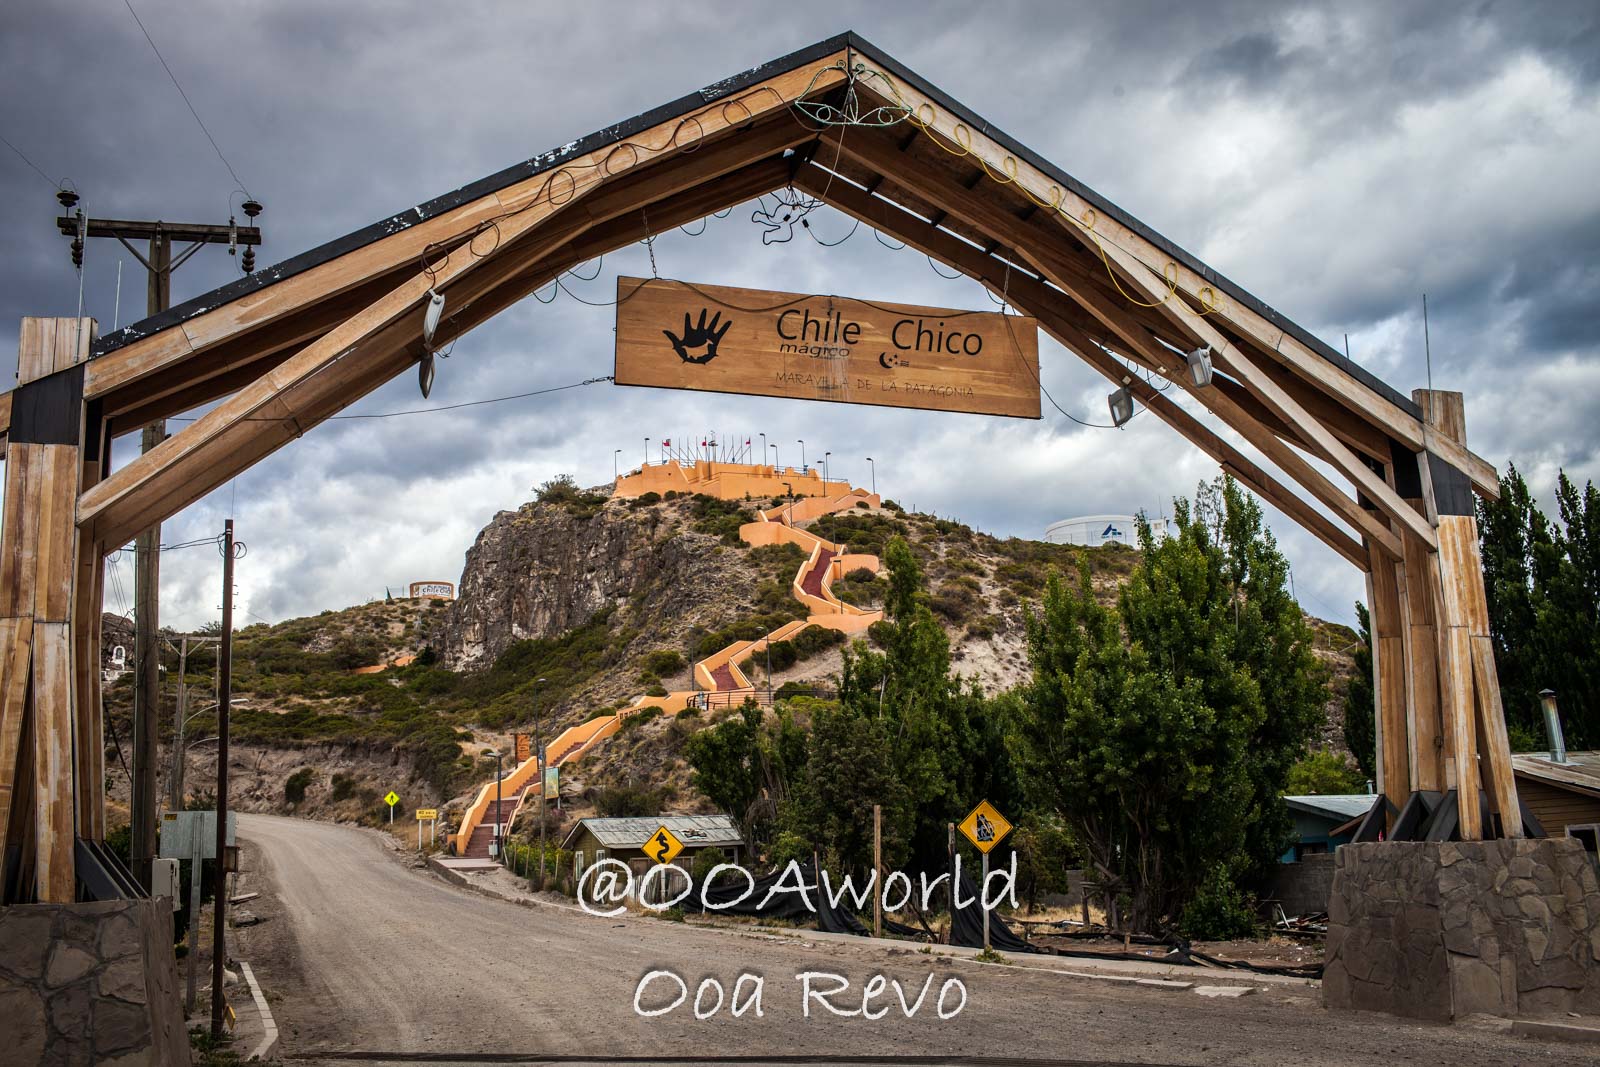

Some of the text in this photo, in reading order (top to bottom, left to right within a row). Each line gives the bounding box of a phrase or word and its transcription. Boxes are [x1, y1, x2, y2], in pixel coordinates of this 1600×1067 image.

[777, 308, 983, 355] Chile Chico
[857, 378, 873, 391] DE
[881, 381, 898, 393] LA
[904, 382, 975, 399] PATAGONIA
